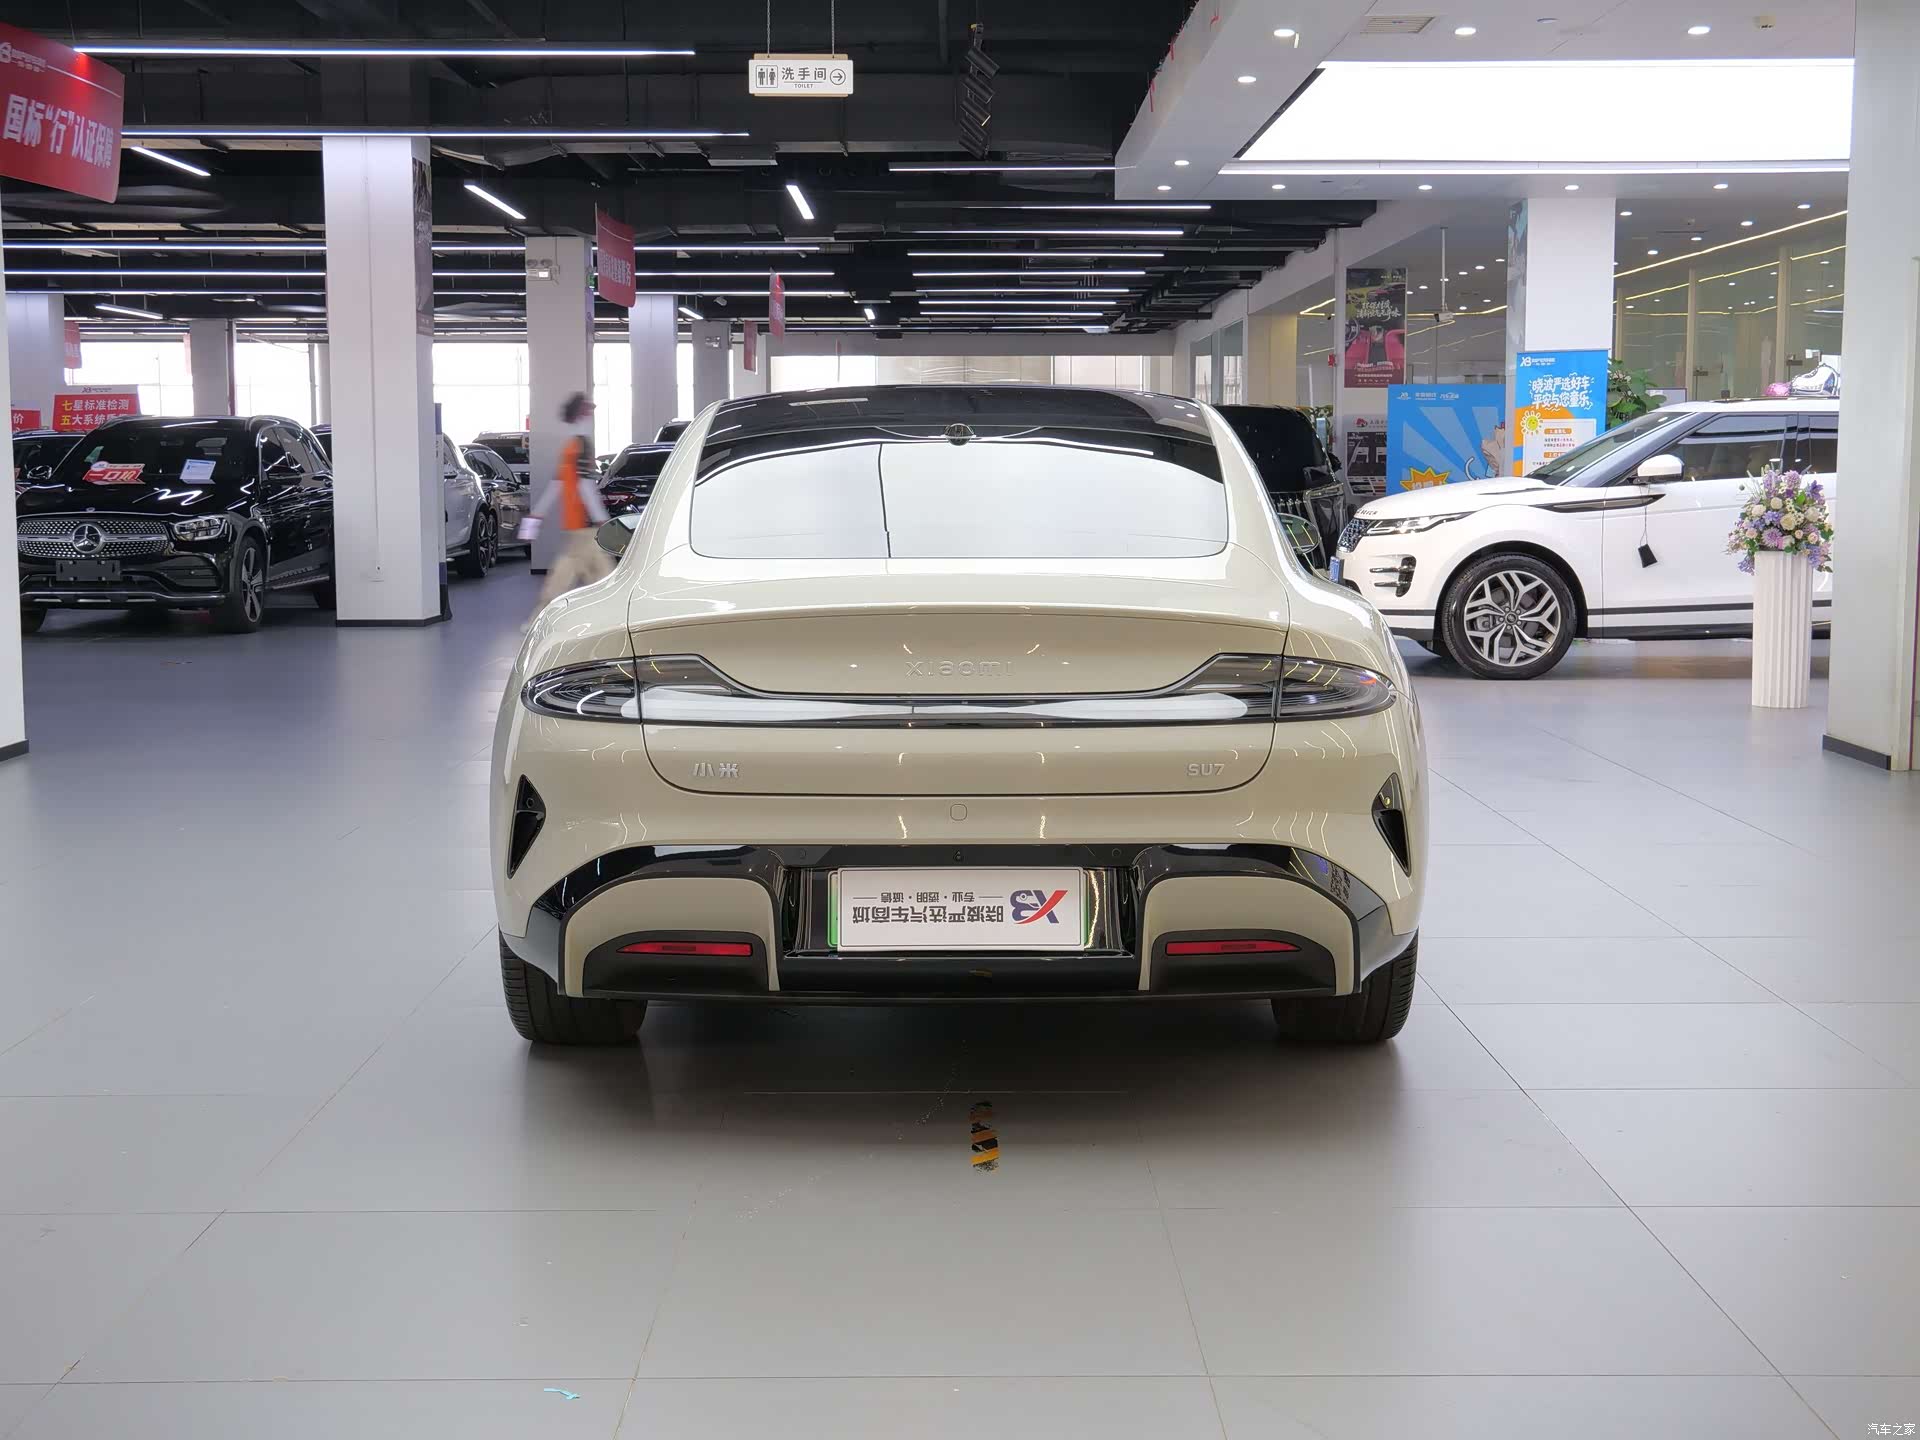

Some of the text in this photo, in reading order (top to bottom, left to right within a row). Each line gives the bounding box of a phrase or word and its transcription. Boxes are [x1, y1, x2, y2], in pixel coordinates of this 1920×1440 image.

[781, 67, 827, 80] 洗手间
[62, 399, 129, 411] 七星标准检测
[60, 413, 129, 426] 五大系统
[692, 762, 739, 778] 小米
[1188, 763, 1225, 776] SU7
[852, 905, 1004, 924] 晓波严选汽车商城
